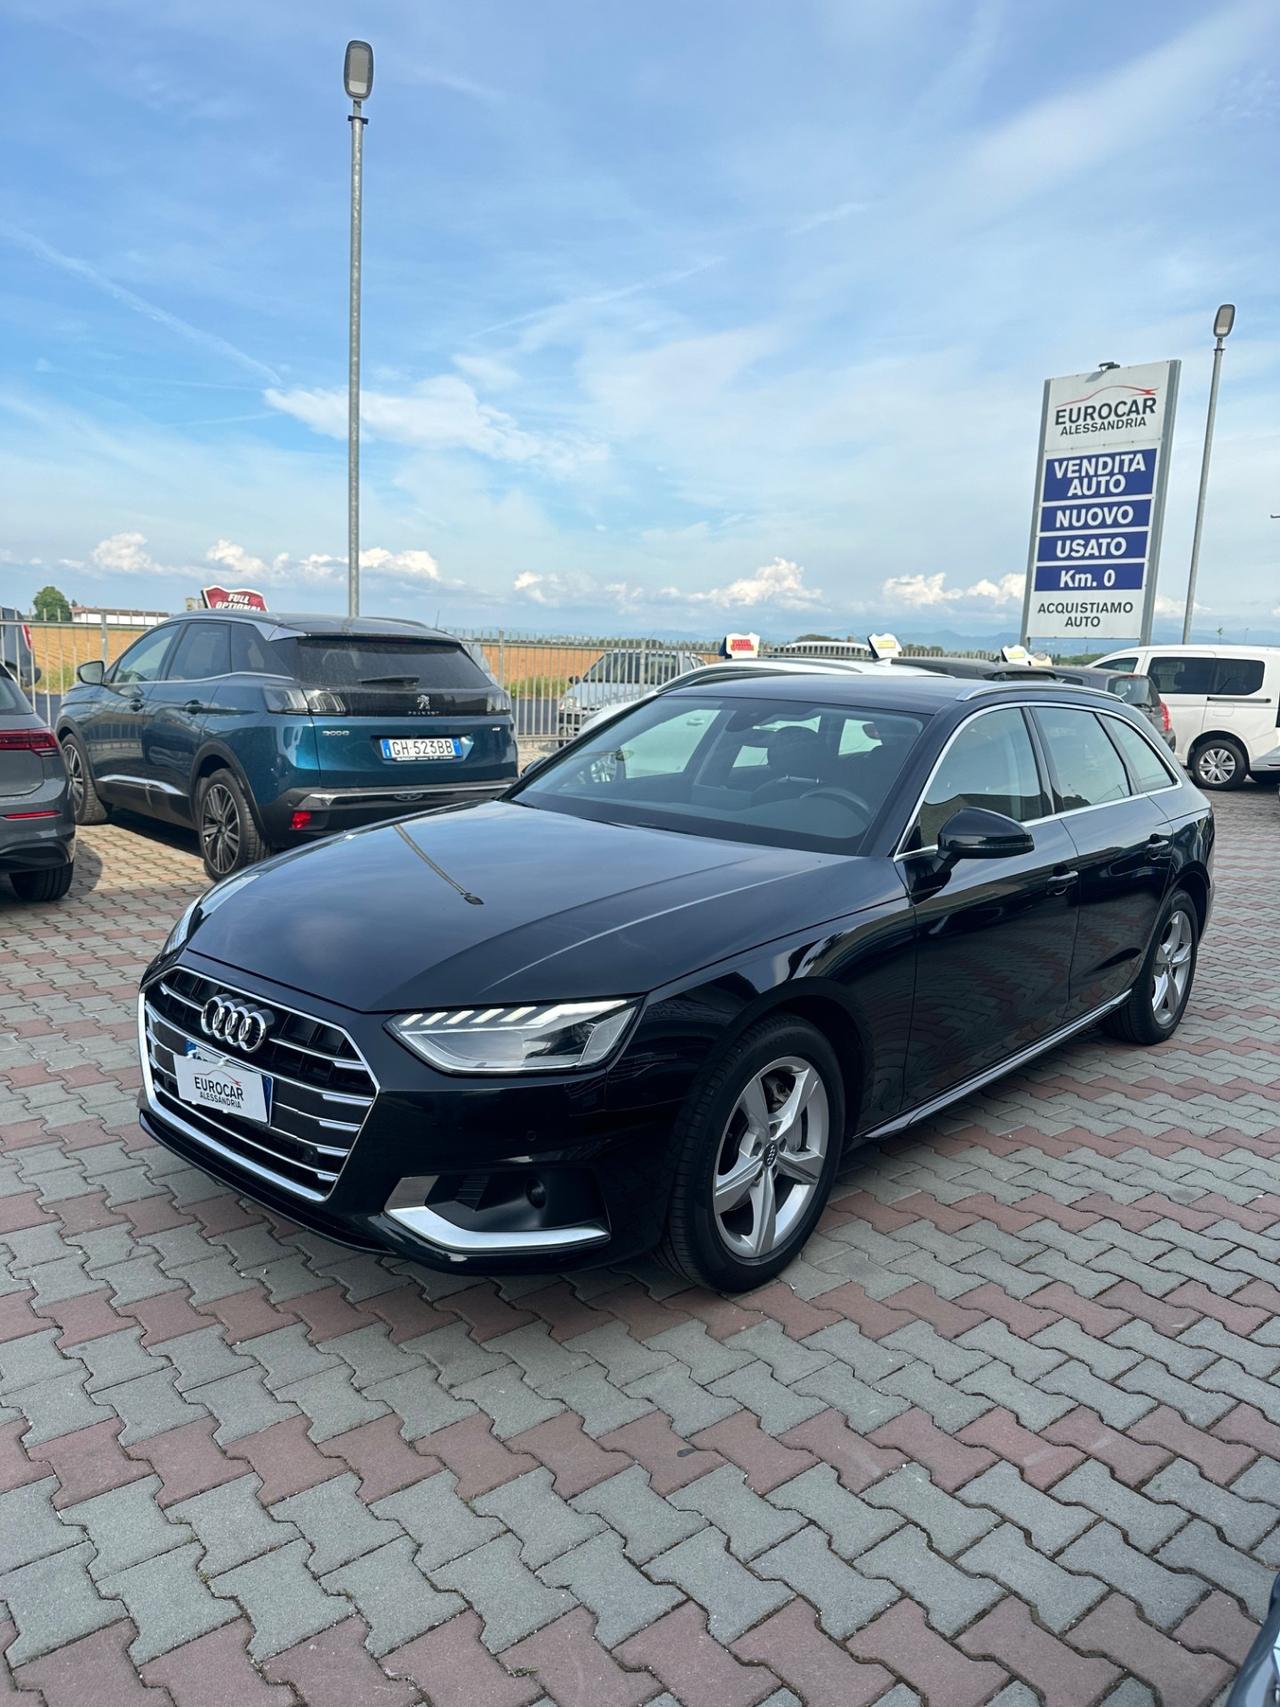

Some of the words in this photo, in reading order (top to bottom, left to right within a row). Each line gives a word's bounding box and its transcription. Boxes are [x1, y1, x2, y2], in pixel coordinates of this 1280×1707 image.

[1055, 397, 1157, 426] EUROCAR
[1060, 417, 1147, 436] ALESSANDRIA
[1053, 454, 1147, 479] VENDITA
[1067, 474, 1126, 497] AUTO
[1055, 505, 1134, 528] NUOVO
[1056, 537, 1127, 558] USATO
[1059, 570, 1097, 588] Km.
[1103, 569, 1116, 587] 0
[228, 593, 250, 604] FULL
[1037, 601, 1134, 615] ACQUISTIAMO
[1064, 616, 1101, 628] AUTO
[392, 741, 410, 756] GH
[413, 740, 453, 755] 523BB
[194, 1076, 244, 1102] EUROCAR
[199, 1091, 242, 1109] ALESSANDRIA
